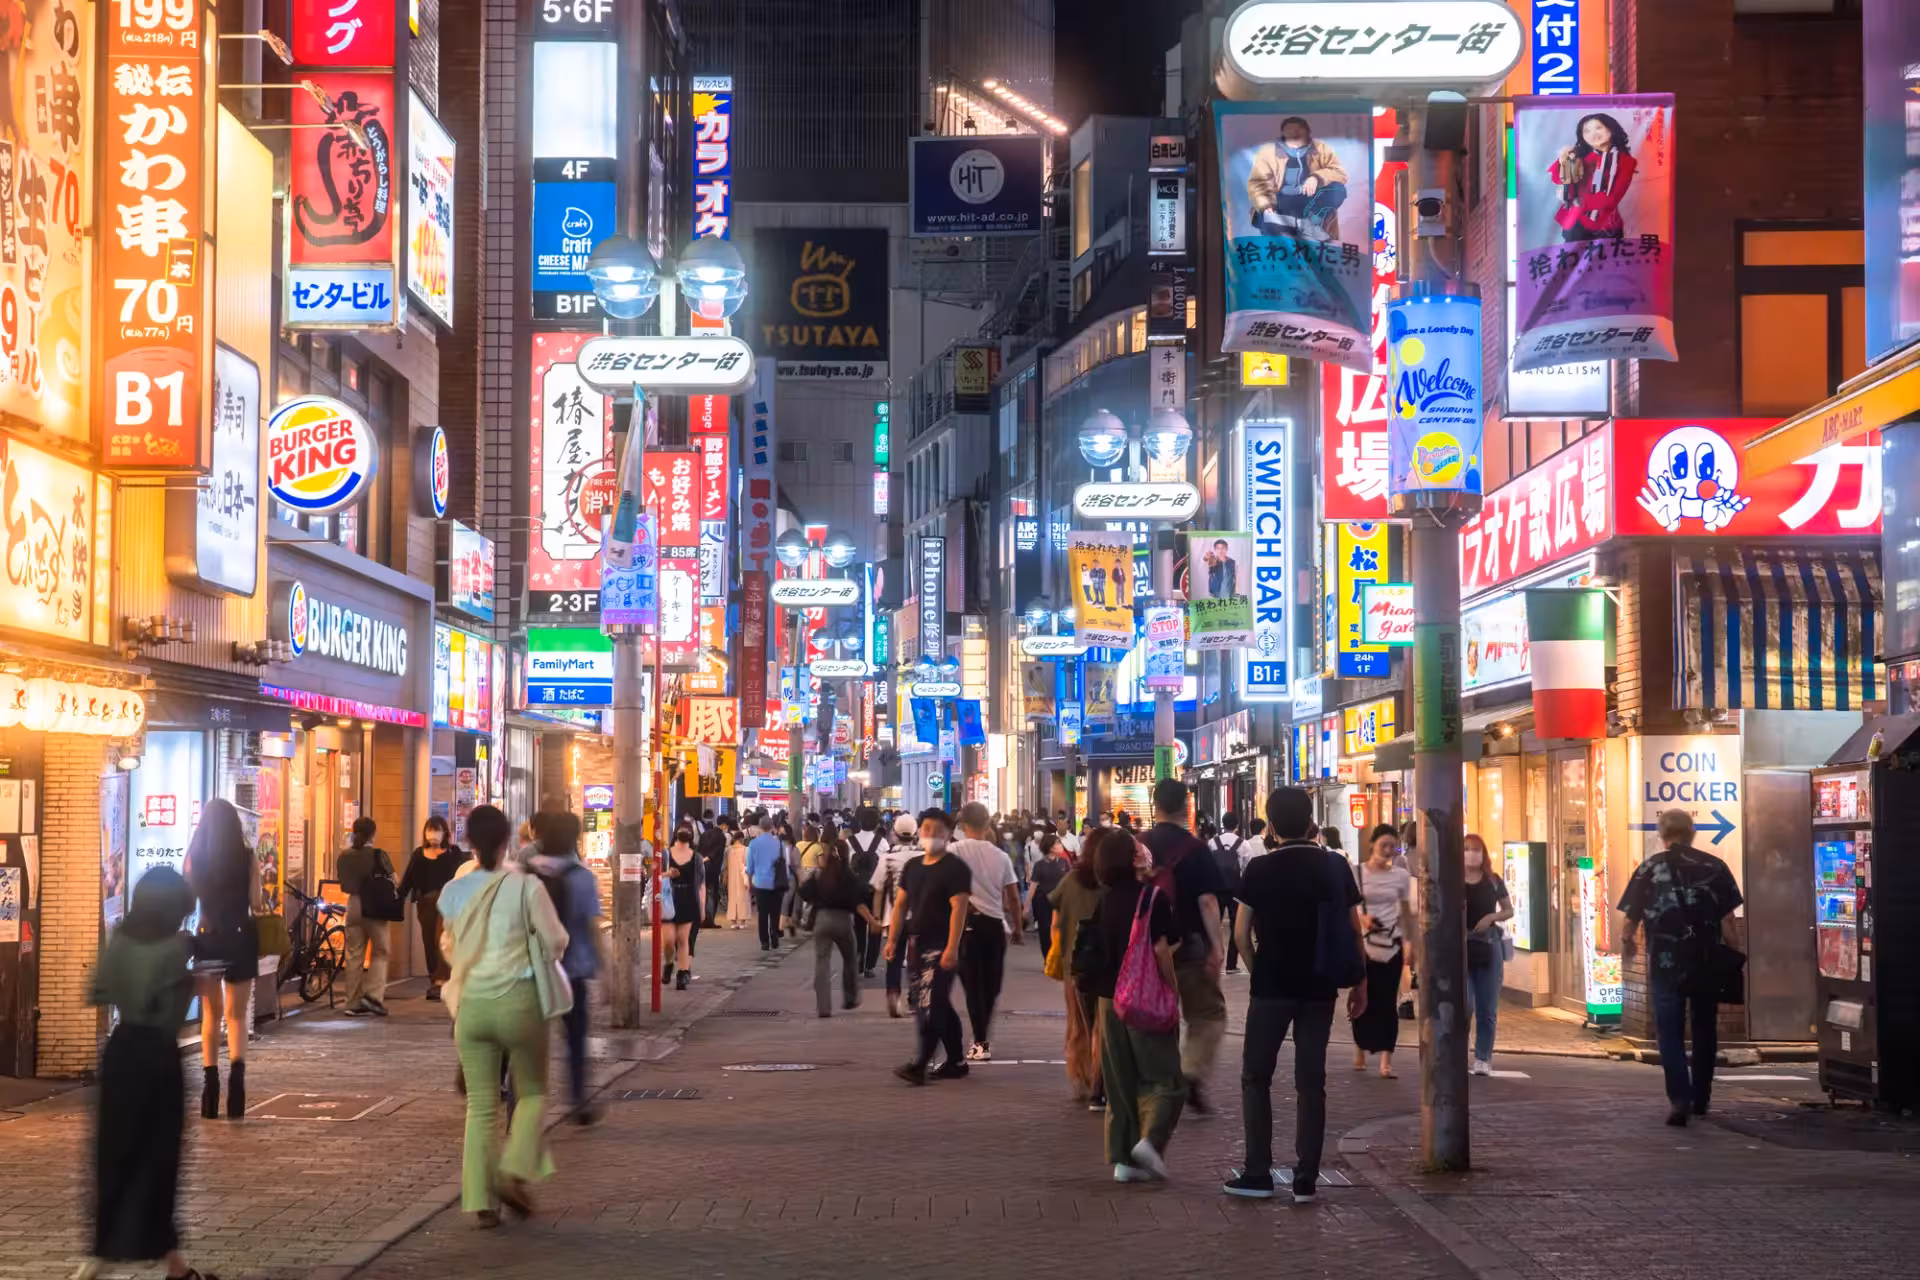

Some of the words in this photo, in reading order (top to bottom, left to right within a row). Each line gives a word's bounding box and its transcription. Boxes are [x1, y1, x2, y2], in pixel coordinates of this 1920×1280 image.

[181, 31, 197, 48] 円
[1242, 23, 1506, 56] 渋谷センター街
[114, 64, 193, 97] 秘伝
[696, 80, 729, 89] プリンスビル
[115, 103, 188, 257] かわ串
[561, 160, 589, 179] 4F
[695, 111, 730, 240] カラオケ
[50, 158, 79, 236] 70
[1157, 184, 1178, 194] MCC
[927, 212, 1029, 222] www.hit-ad.co.jp
[562, 237, 592, 253] Craft
[1236, 241, 1361, 267] 拾われた男
[538, 255, 570, 266] CHEESE
[1528, 233, 1662, 281] 拾われた男
[18, 152, 48, 392] 生ビール
[113, 279, 178, 323] 70
[292, 281, 391, 310] センタービル
[556, 295, 597, 313] B1F
[176, 315, 193, 334] 円
[1428, 325, 1459, 335] Lovely
[763, 326, 880, 347] TSUTAYA
[1246, 322, 1356, 351] 渋谷センター街
[1534, 326, 1656, 352] 渋谷センター街
[587, 351, 745, 371] 渋谷センター街
[1396, 358, 1476, 414] Welcome
[115, 371, 184, 427] B1
[1428, 406, 1474, 414] SHIBUYA
[1822, 406, 1864, 443] ABC-MART
[269, 419, 354, 459] BURGER
[272, 438, 357, 487] KING
[552, 386, 595, 537] 椿屋カフェ
[590, 478, 603, 486] FIRE
[1778, 441, 1883, 530] カ
[671, 458, 691, 532] お好み焼
[1081, 493, 1193, 508] 渋谷センター街
[1255, 440, 1282, 558] SWITCH
[671, 546, 697, 558] 85席
[672, 574, 682, 623] ケーキと
[775, 587, 853, 598] 渋谷センター街
[1255, 566, 1283, 624] BAR
[308, 597, 370, 667] BURGER
[372, 620, 408, 676] KING
[1151, 619, 1179, 633] STOP
[1026, 641, 1075, 650] 渋谷センター
[533, 659, 594, 672] FamilyMart
[1353, 654, 1374, 662] 24h
[1254, 665, 1280, 681] B1F
[542, 687, 555, 701] 酒
[559, 689, 585, 700] たばこ
[687, 699, 734, 743] 豚
[1659, 751, 1716, 773] COIN
[1114, 765, 1156, 784] SHIB
[1645, 781, 1738, 802] LOCKER
[135, 848, 184, 858] にぎりたて
[1599, 987, 1622, 997] OPE
